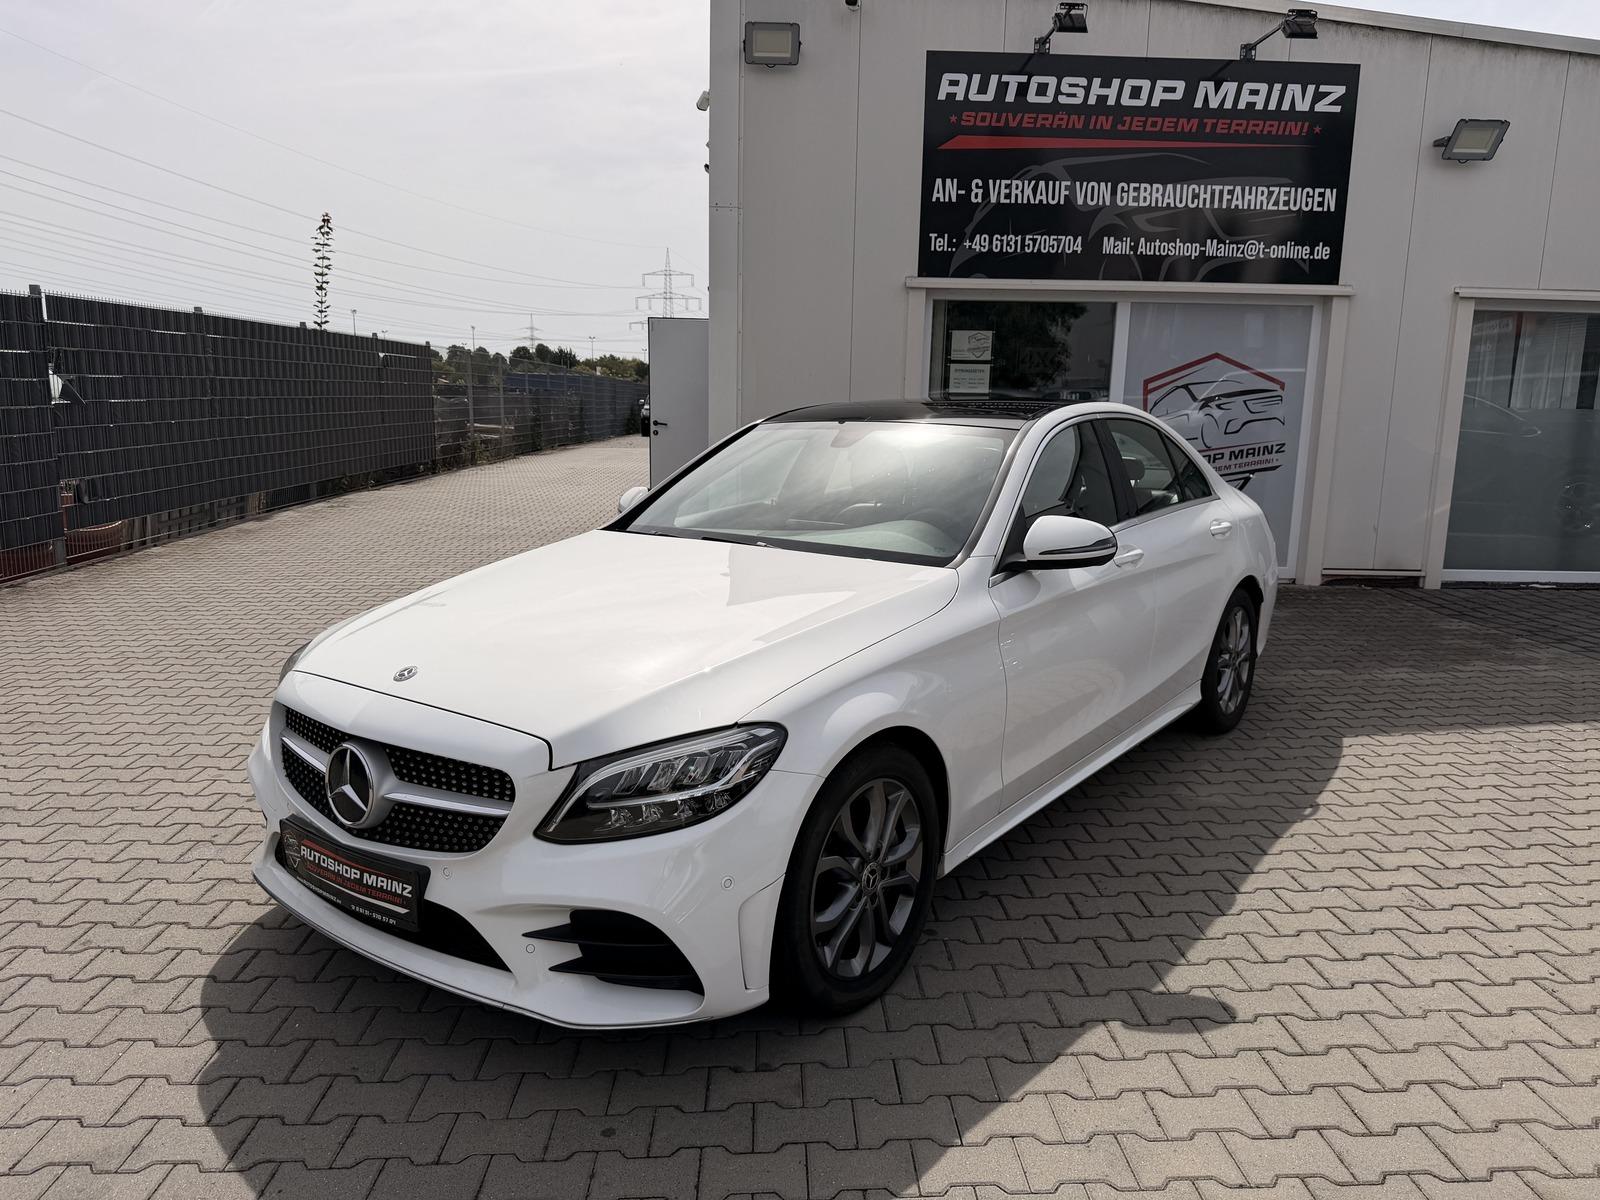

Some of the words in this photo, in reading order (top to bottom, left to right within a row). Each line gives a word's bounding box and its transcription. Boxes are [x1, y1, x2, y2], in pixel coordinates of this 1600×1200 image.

[937, 72, 1186, 107] AUTOSHOP
[1193, 80, 1347, 113] MAINZ
[960, 111, 1086, 129] SOUVERÄN
[1089, 114, 1114, 130] IN
[1117, 116, 1200, 133] JEDEM
[1203, 118, 1310, 136] TERRAIN!
[931, 177, 966, 203] AN-
[970, 178, 984, 204] &
[988, 178, 1071, 206] VERKAUF
[1075, 181, 1112, 206] VON
[1116, 182, 1337, 212] GEBRAUCHTFAHRZEUGEN
[929, 233, 957, 252] Tel.:
[963, 233, 989, 253] +49
[992, 234, 1021, 253] 6131
[1024, 235, 1083, 254] 5705704
[1102, 236, 1135, 255] Mail:
[1137, 237, 1331, 260] Autoshop-Mainz@t-online.de
[1229, 443, 1286, 461] MAINZ
[300, 845, 361, 880] AUTOSHOP
[363, 872, 413, 898] MAINZ
